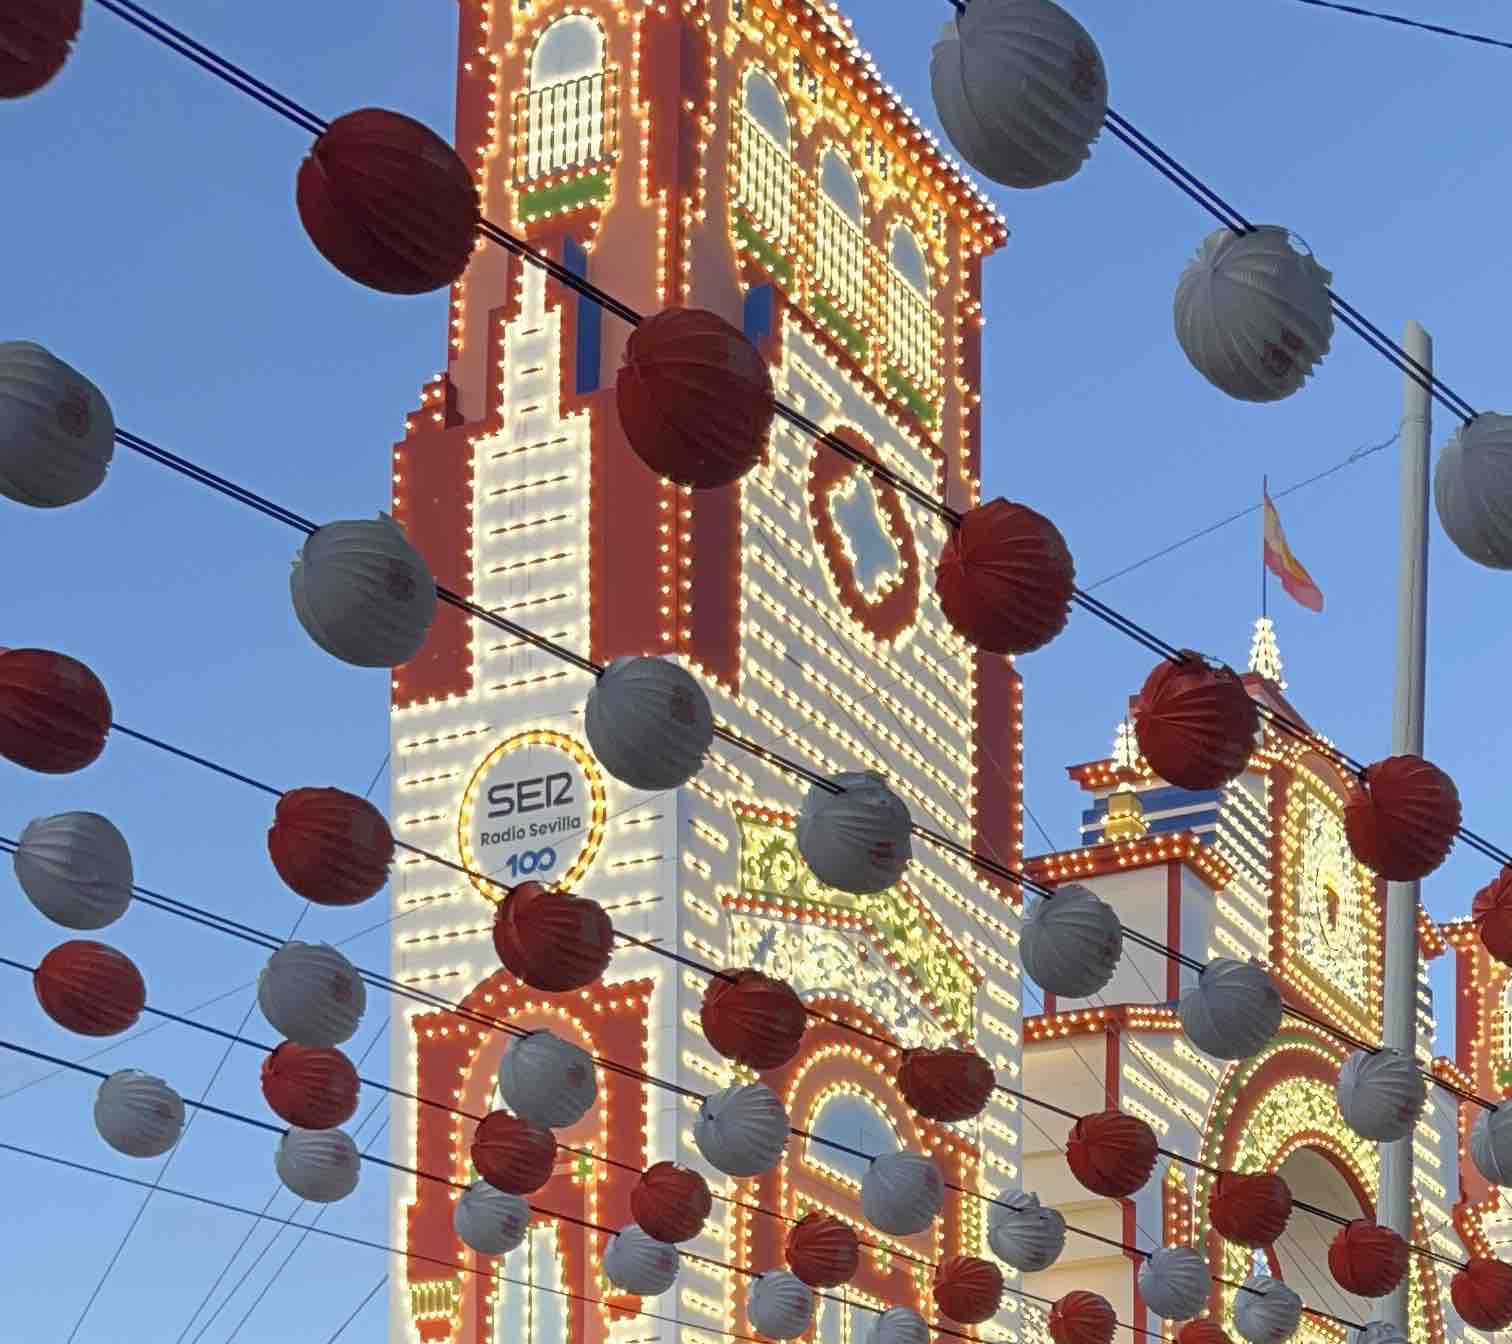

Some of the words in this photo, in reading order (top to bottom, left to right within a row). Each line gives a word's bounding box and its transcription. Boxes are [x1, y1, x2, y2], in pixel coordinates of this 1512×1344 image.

[487, 771, 575, 819] SER
[480, 825, 526, 847] Radio
[529, 815, 581, 838] Sevilla
[505, 847, 557, 878] 100
